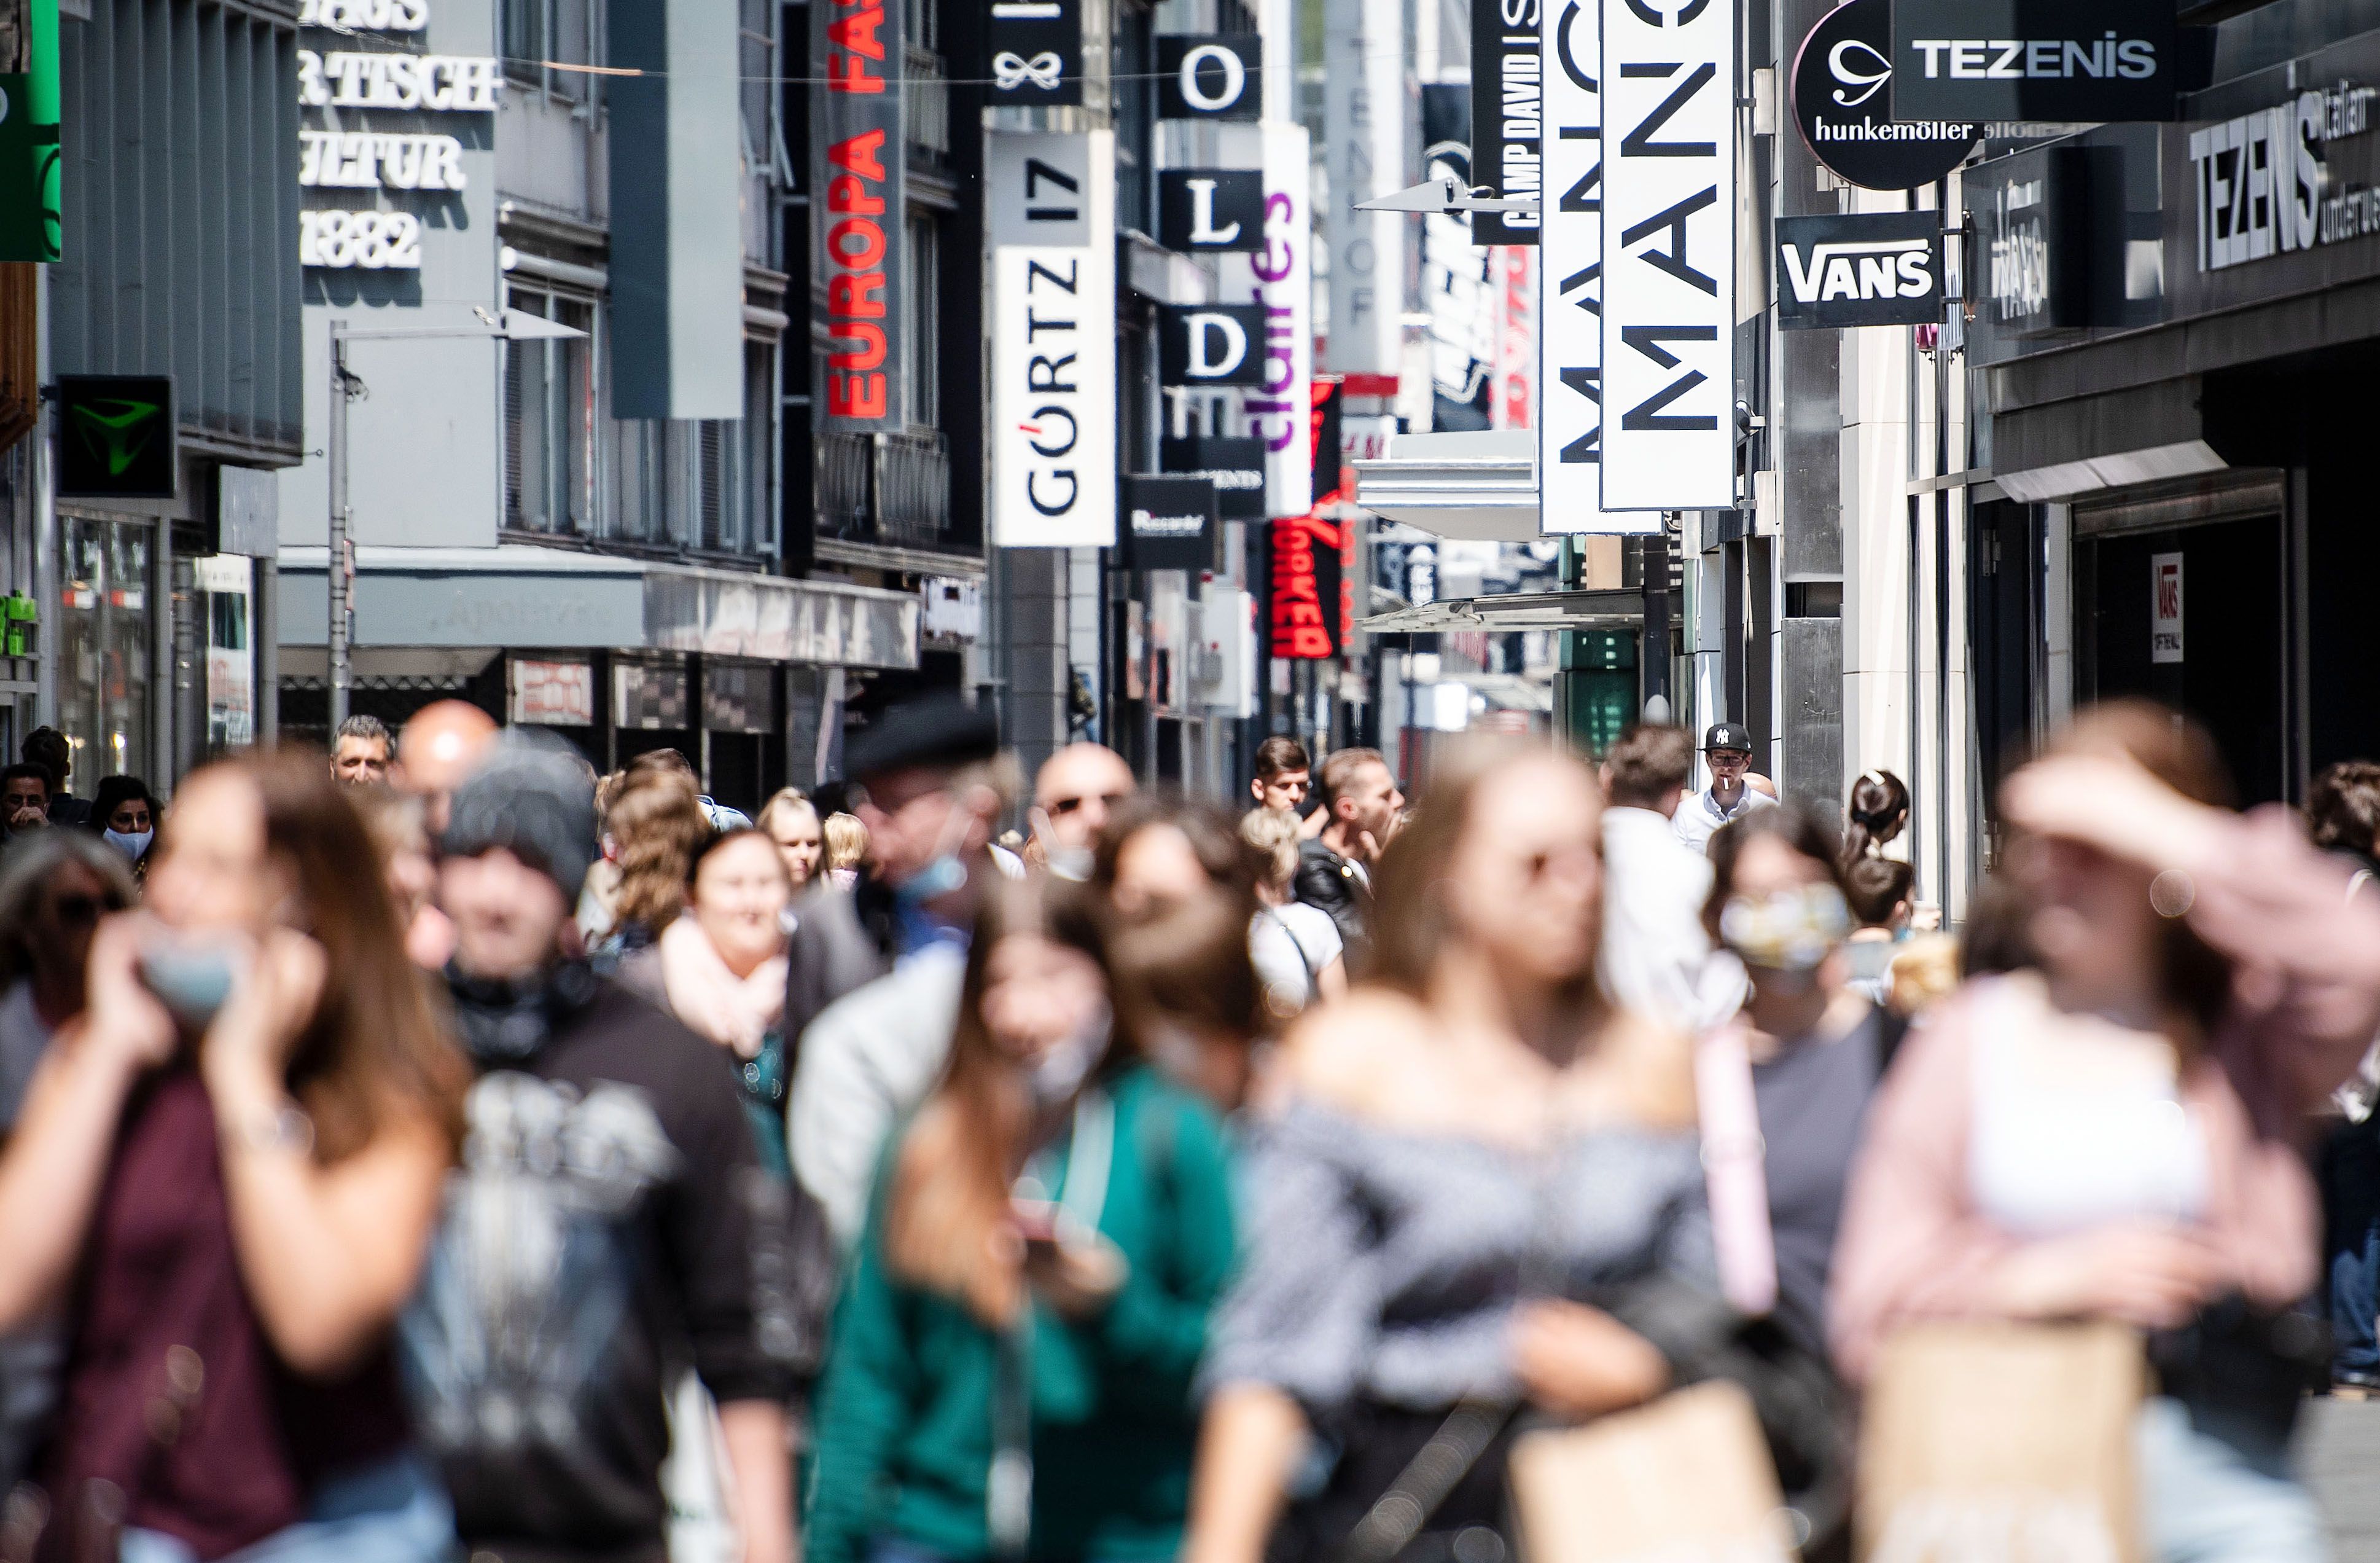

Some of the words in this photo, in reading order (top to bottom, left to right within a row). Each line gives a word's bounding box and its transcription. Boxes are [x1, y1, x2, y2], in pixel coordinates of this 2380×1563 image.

[827, 0, 886, 93] FA
[1503, 53, 1540, 138] DAVID
[1815, 116, 1973, 141] hunkemöller
[1026, 158, 1079, 221] 17
[1620, 0, 1718, 430] MAN
[300, 210, 421, 268] 1882
[827, 128, 888, 419] EUROPA
[1781, 238, 1933, 303] VANS
